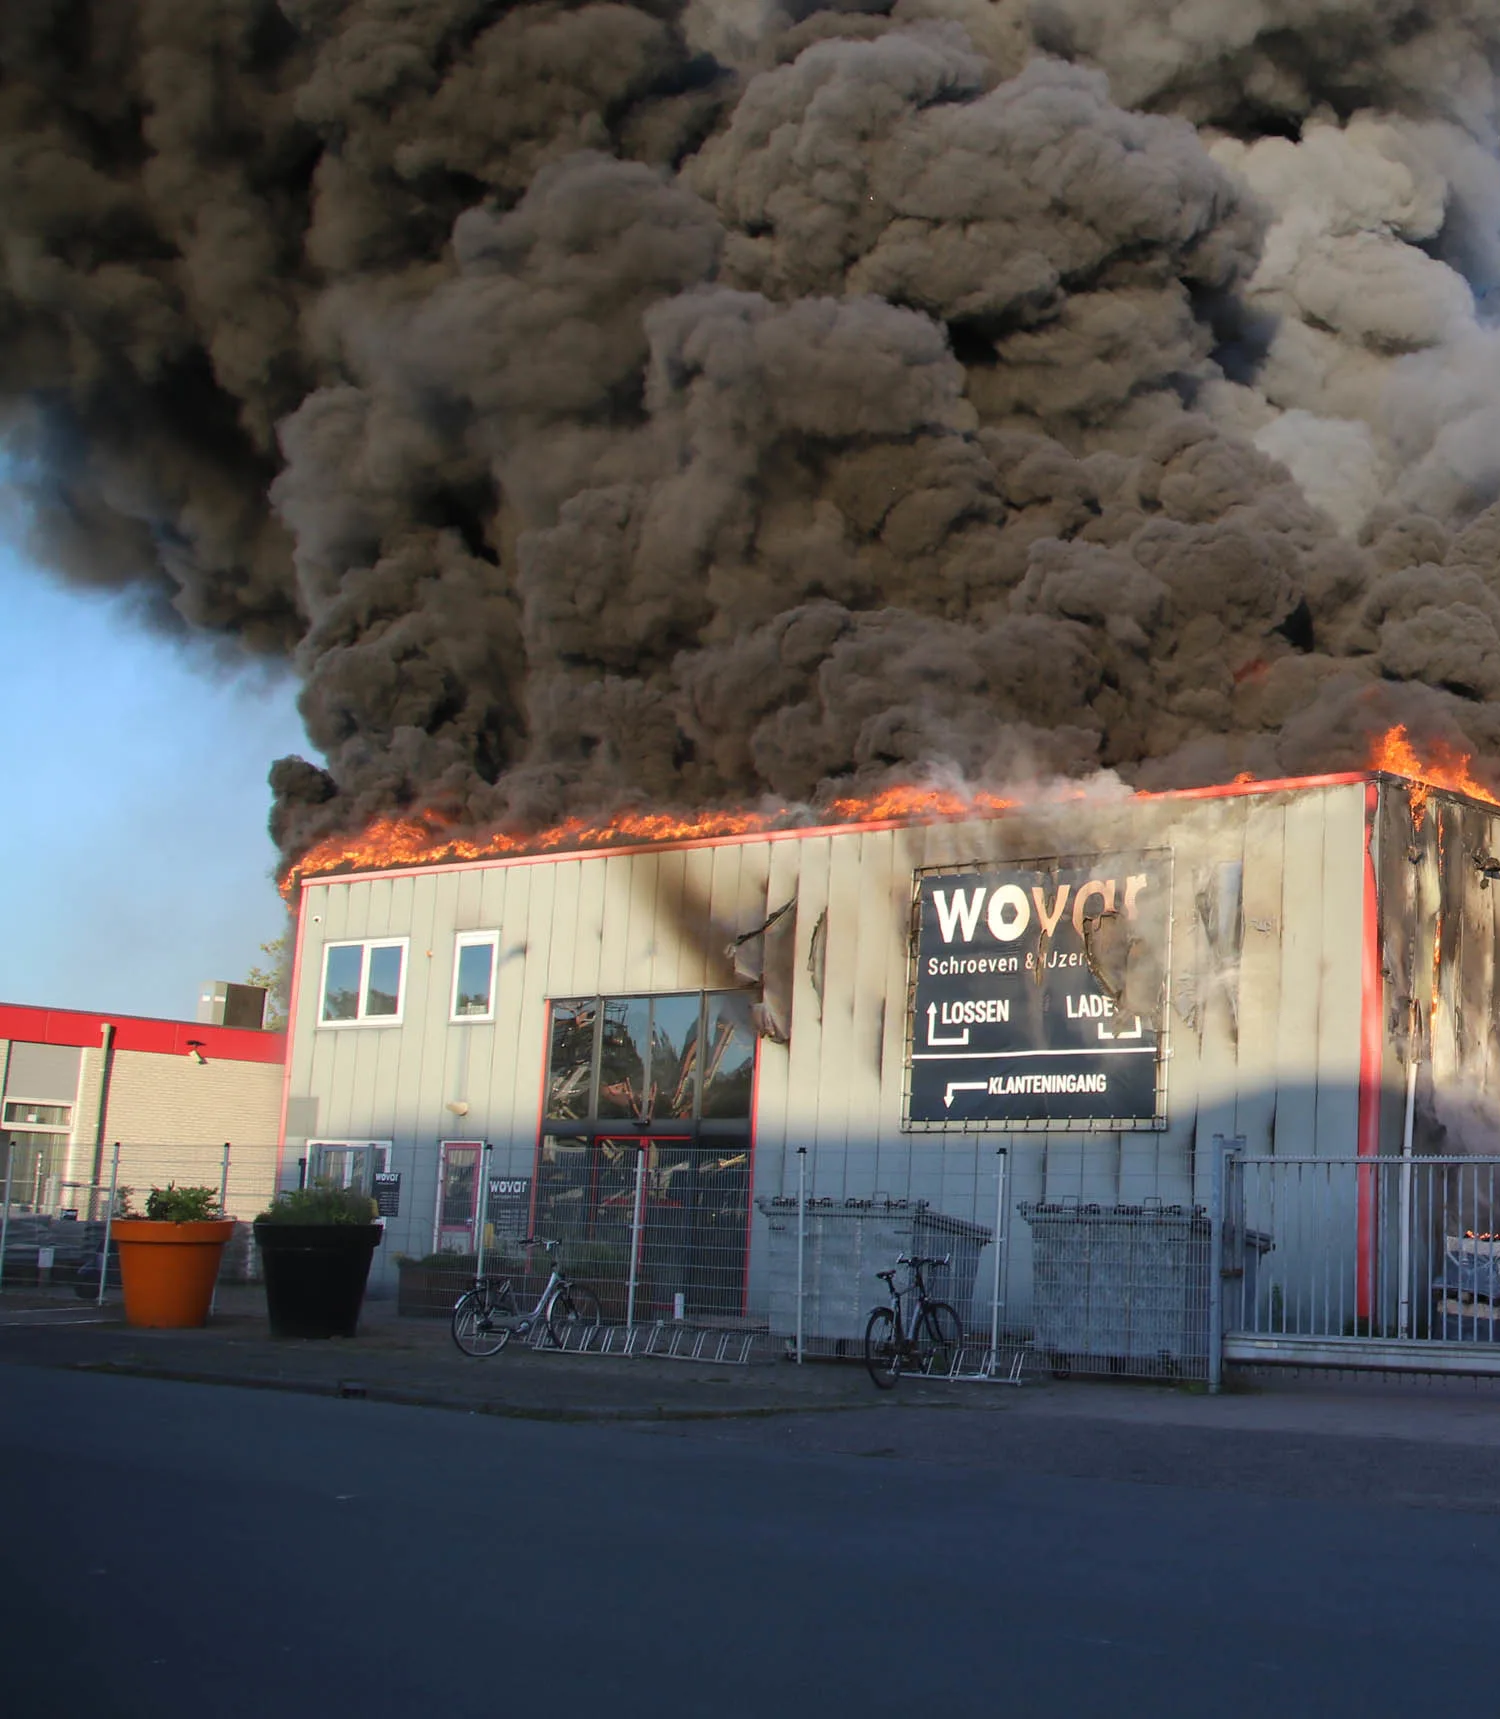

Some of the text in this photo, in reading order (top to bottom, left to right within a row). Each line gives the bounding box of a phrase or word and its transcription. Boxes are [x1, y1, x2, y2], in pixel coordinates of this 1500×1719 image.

[927, 955, 1018, 976] Schroeven
[1025, 952, 1034, 970] &
[941, 994, 1119, 1025] LOSSEN LADE
[988, 1074, 1107, 1095] KLANTENINGANG
[489, 1180, 527, 1193] wovar
